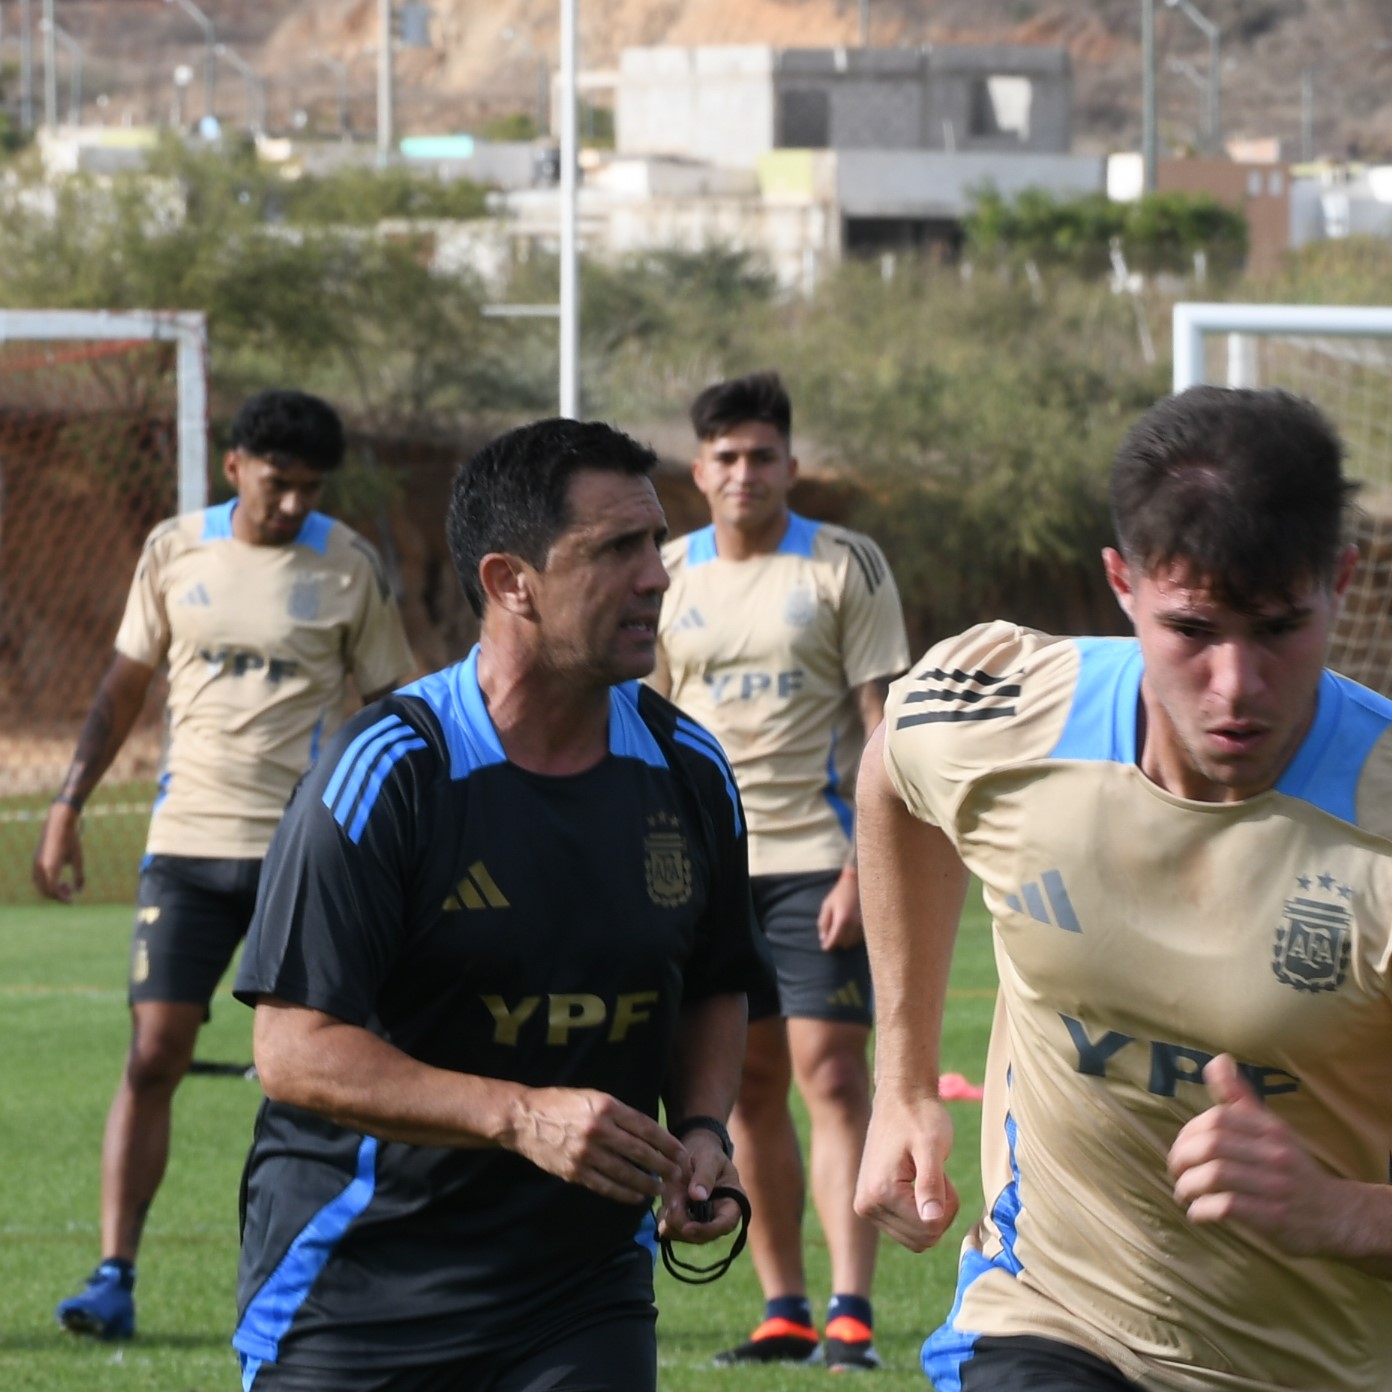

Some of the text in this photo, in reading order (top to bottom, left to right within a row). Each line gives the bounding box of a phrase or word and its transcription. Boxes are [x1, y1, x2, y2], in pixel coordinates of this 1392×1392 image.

[200, 648, 298, 683] YPF
[702, 669, 804, 702] YPF
[479, 991, 659, 1047] YPF
